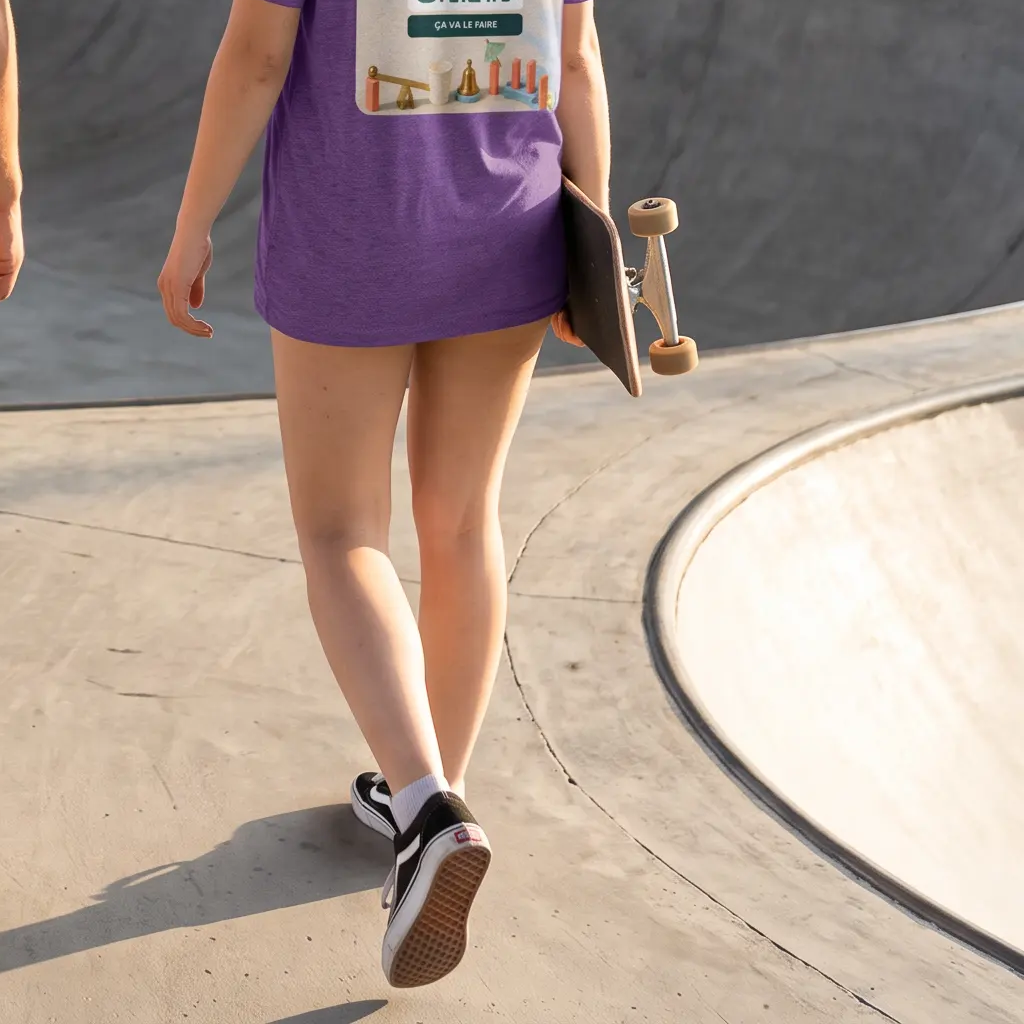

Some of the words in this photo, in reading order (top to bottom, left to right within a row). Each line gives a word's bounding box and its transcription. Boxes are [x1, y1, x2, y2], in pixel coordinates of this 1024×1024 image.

[434, 21, 447, 31] ÇA
[449, 21, 461, 29] VA
[463, 21, 473, 29] LE
[475, 20, 497, 29] FAIRE
